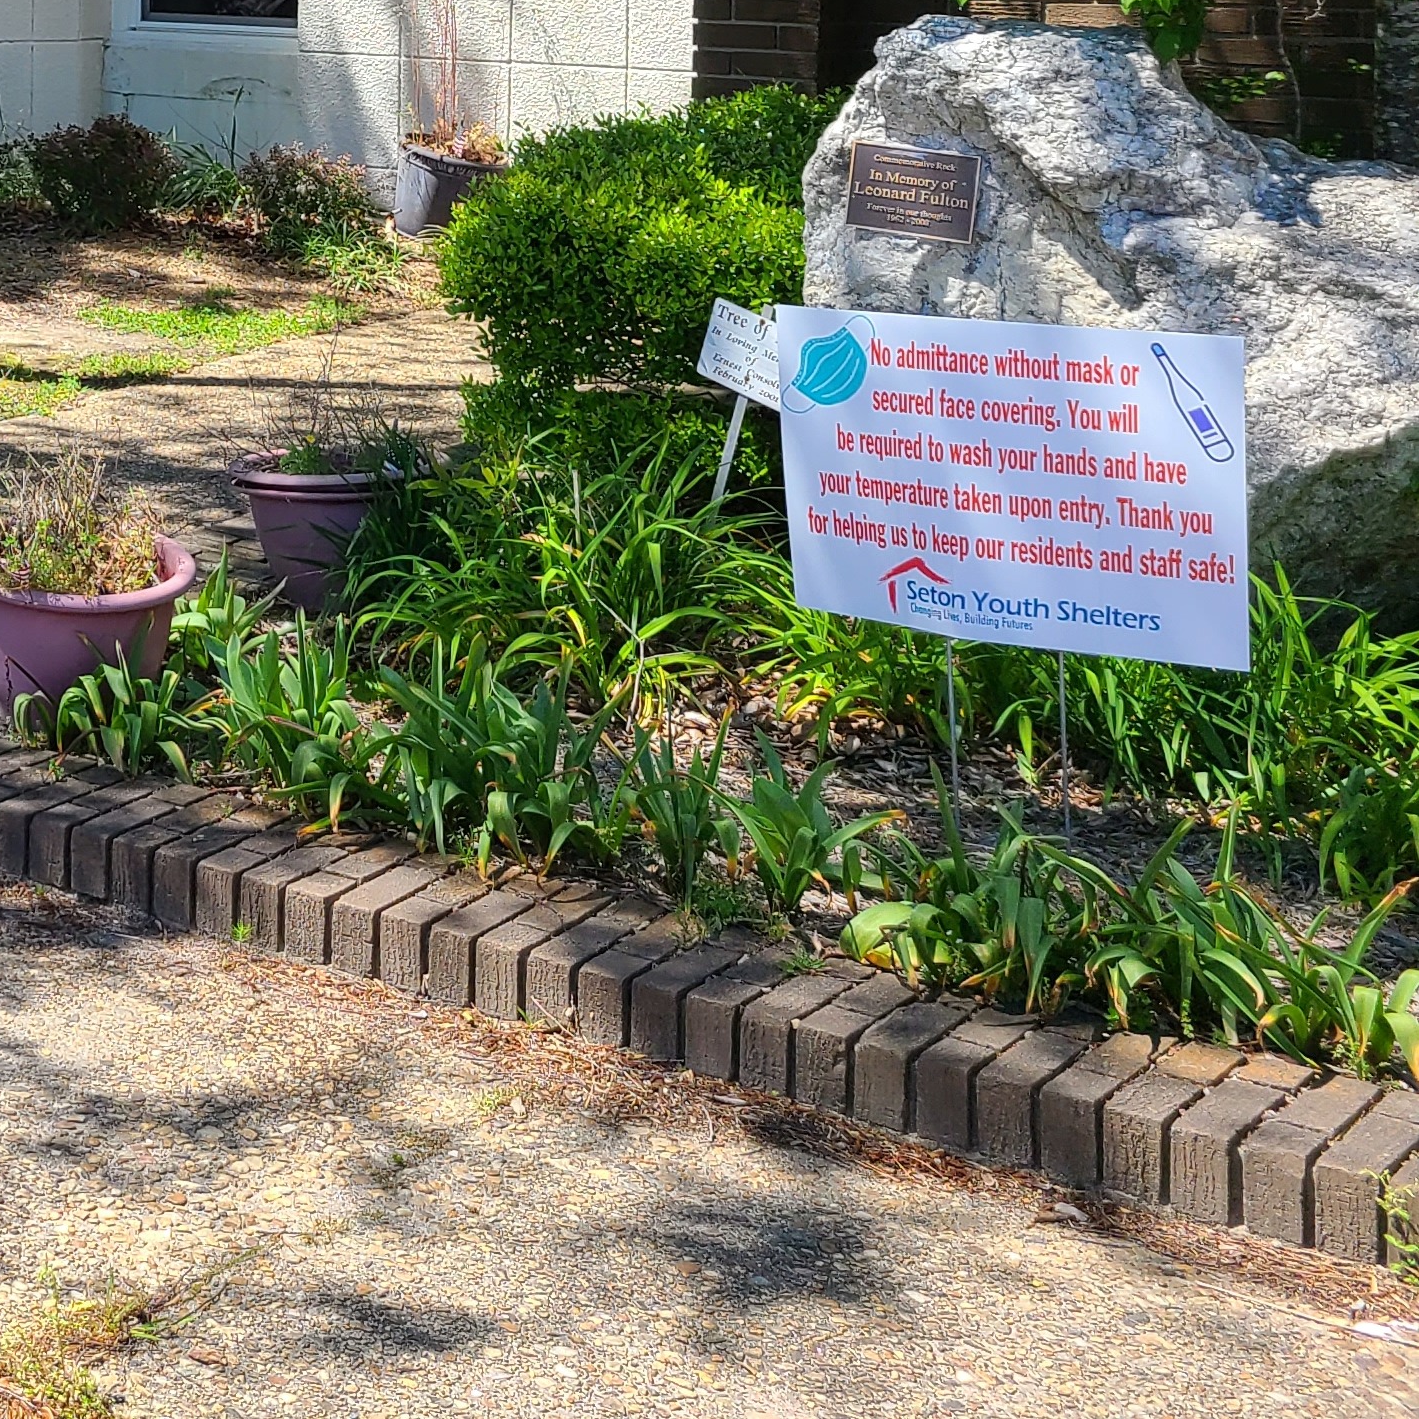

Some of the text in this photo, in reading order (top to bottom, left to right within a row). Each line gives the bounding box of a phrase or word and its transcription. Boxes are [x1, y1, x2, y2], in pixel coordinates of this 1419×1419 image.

[854, 181, 969, 209] Leonard Fulton
[869, 168, 957, 191] In Memory of
[711, 325, 722, 336] In
[725, 332, 758, 354] Loving
[718, 303, 772, 342] Tree of
[712, 352, 742, 372] Ernest
[745, 356, 759, 366] of
[870, 338, 1140, 387] No admittance without mask or
[712, 366, 754, 392] February
[872, 388, 1139, 434] secured face covering. You will
[836, 423, 1187, 485] be required to wash your hands and have
[818, 470, 1213, 538] your temperature taken upon entry. Thank you
[808, 506, 1236, 584] for helping us to keep our residents and staff safe!
[907, 580, 1161, 631] Seton Youth Shelters
[964, 612, 999, 629] Building
[1001, 617, 1033, 630] Futures
